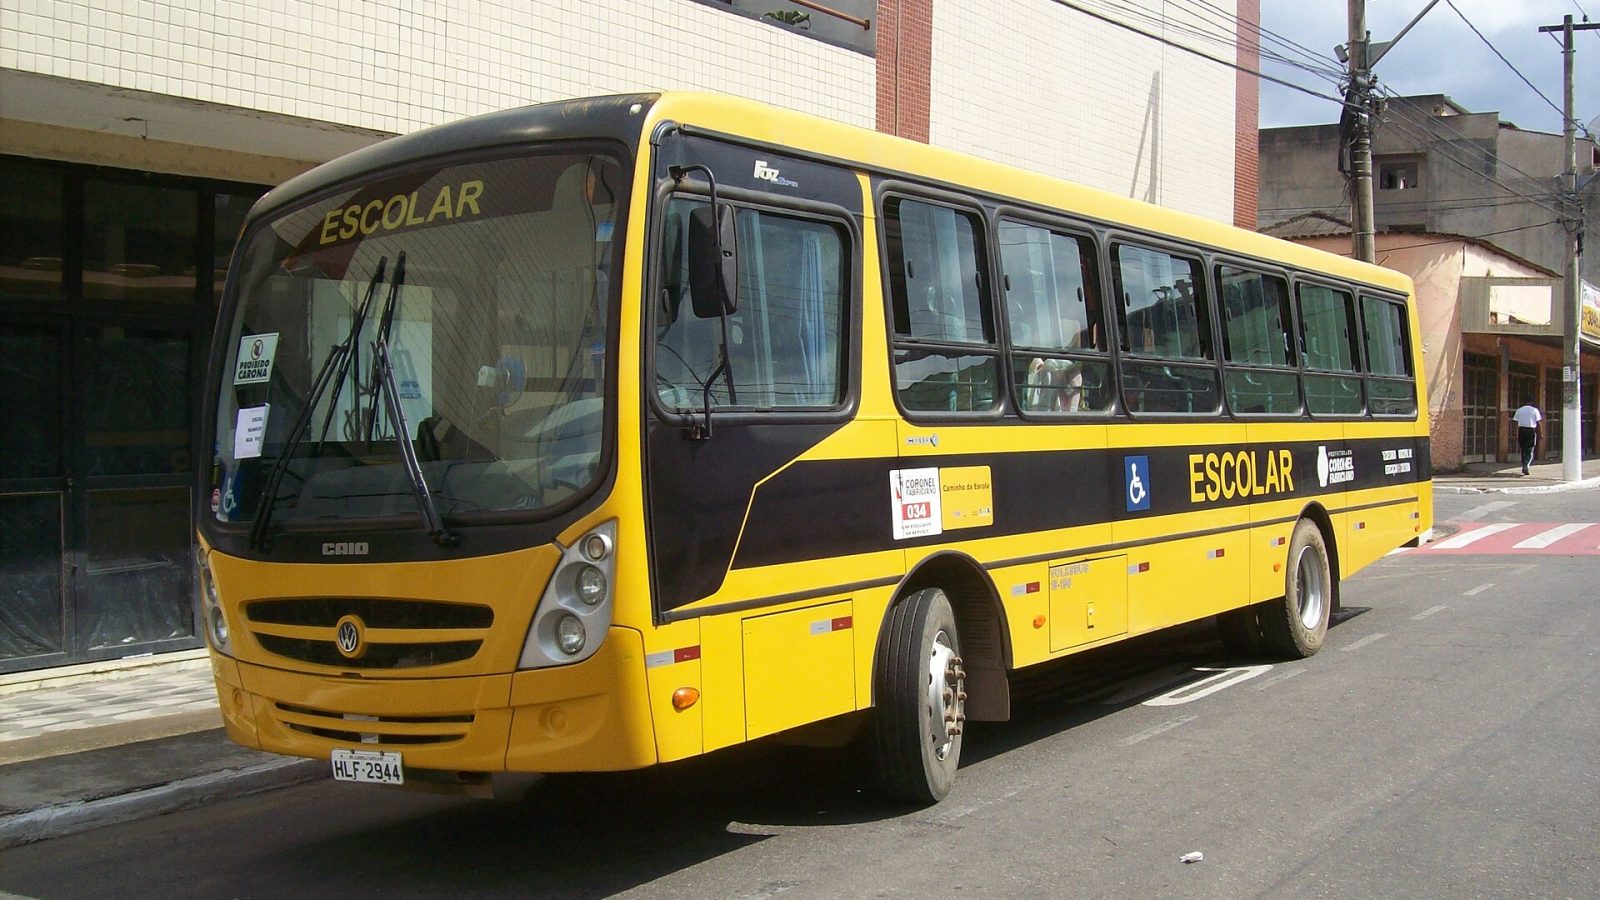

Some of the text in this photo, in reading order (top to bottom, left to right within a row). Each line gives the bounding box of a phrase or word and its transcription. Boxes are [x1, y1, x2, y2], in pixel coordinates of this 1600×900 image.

[320, 180, 484, 245] ESCOLAR
[239, 360, 270, 370] PROIBIDO
[238, 368, 267, 379] CARONA
[1189, 449, 1295, 503] ESCOLAR
[905, 478, 935, 488] CORONEL
[943, 484, 966, 492] Caminho
[974, 482, 990, 490] Escola
[907, 504, 927, 519] 034
[322, 543, 369, 555] CAIO
